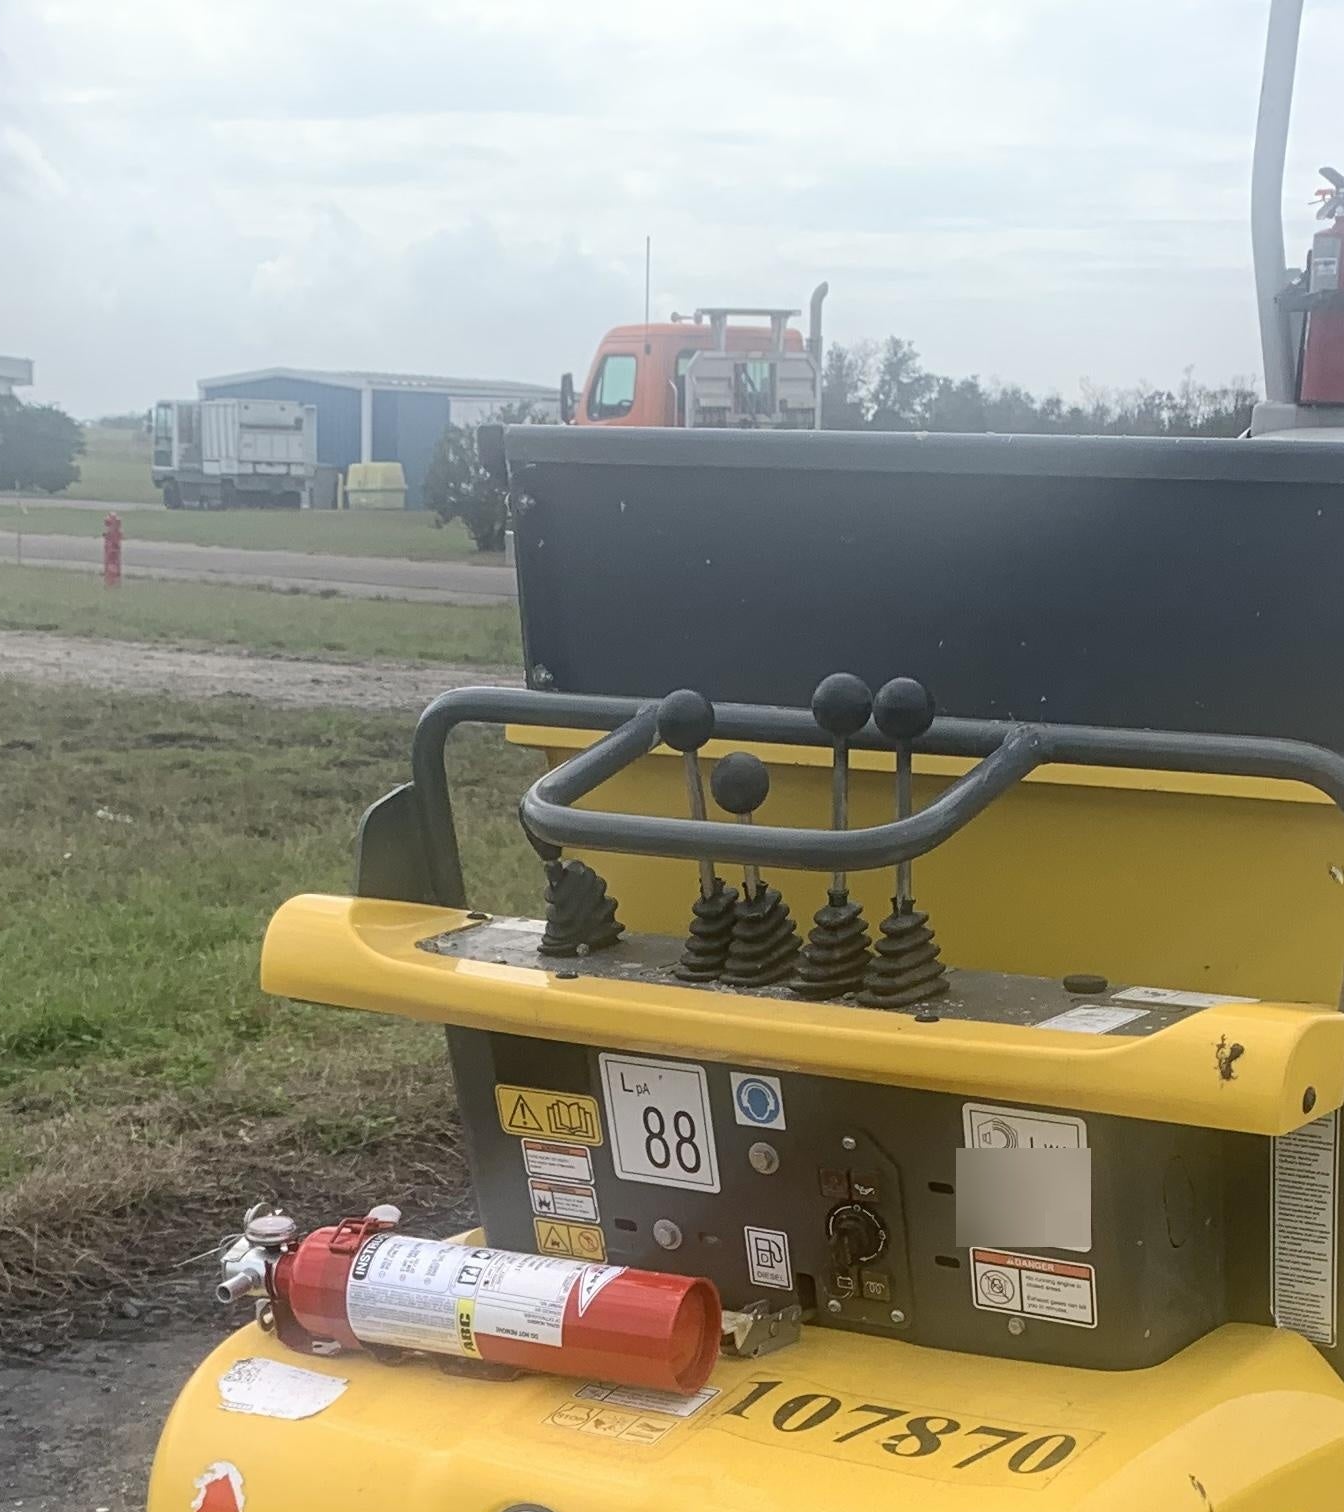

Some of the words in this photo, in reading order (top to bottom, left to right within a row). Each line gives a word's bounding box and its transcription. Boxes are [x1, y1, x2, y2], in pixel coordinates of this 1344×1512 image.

[642, 1106, 701, 1174] 88
[757, 1270, 784, 1282] DIESEL
[1015, 1257, 1055, 1272] DANGER
[459, 1312, 476, 1352] ABC
[723, 1380, 1077, 1474] 107870
